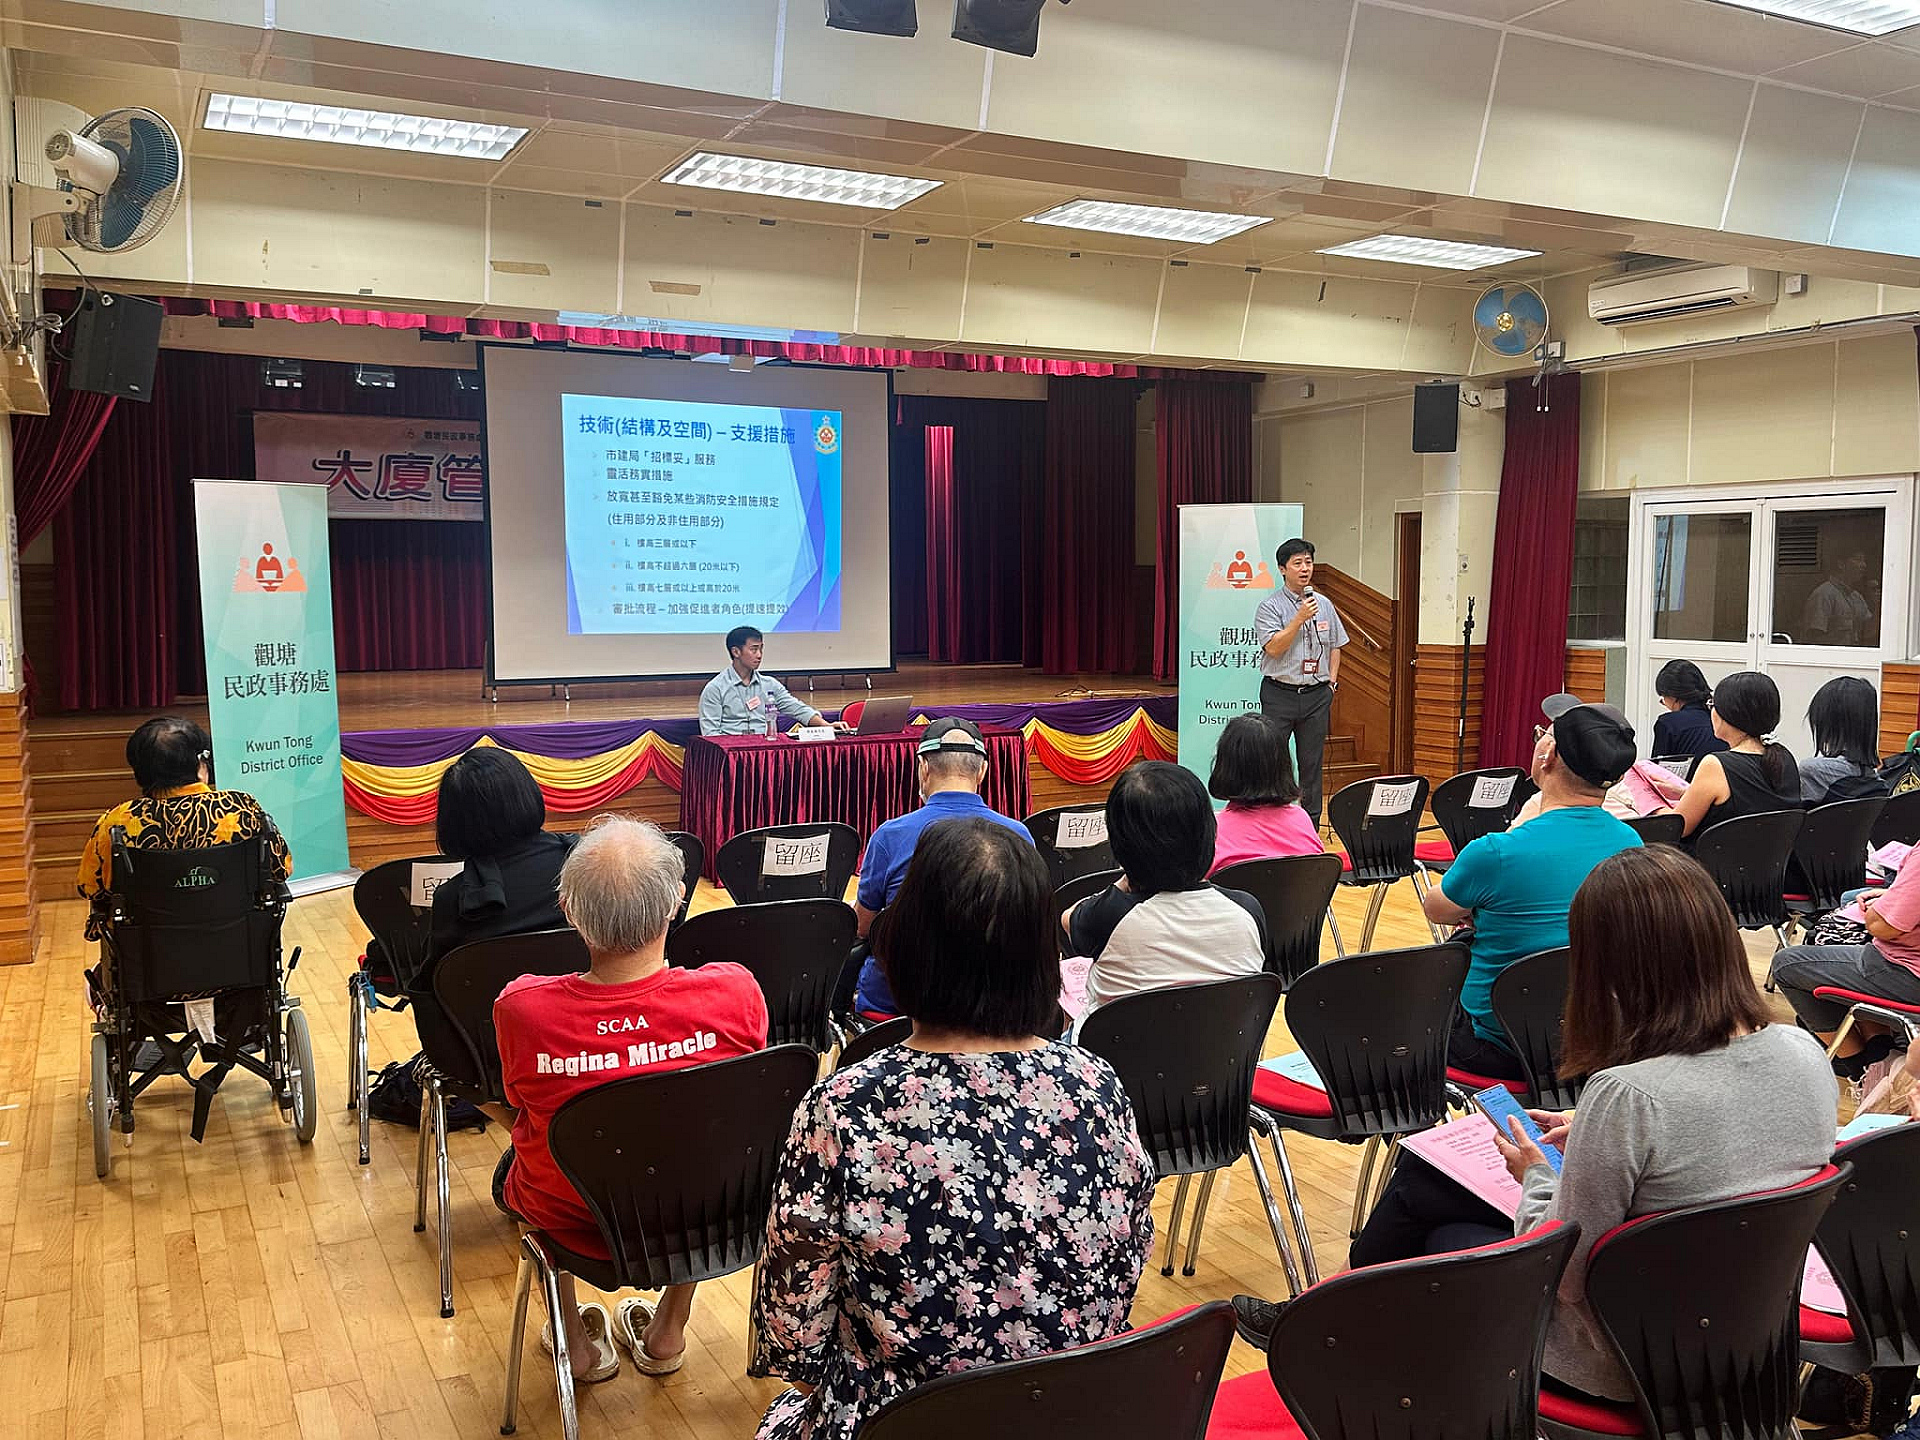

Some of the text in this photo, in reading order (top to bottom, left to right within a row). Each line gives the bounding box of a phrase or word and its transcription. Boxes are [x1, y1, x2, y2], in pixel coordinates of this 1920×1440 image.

[579, 414, 712, 442] 技術(結構及空間)
[730, 424, 796, 444] 支援措施
[312, 450, 482, 501] 大廈管
[607, 513, 724, 529] (住用部分及非住用部分)
[1219, 627, 1258, 646] 觀塘
[254, 642, 297, 667] 觀塘
[1190, 650, 1263, 668] 民政事
[224, 669, 330, 700] 民政事務處
[1205, 699, 1261, 709] Kwun Ton
[1199, 714, 1229, 725] Distri
[246, 735, 313, 753] Kwun Tong
[241, 753, 323, 774] District Office
[1380, 786, 1412, 807] 留座
[1068, 816, 1107, 838] 留座
[775, 842, 822, 865] 留座
[172, 875, 216, 887] ALPHA
[596, 1014, 649, 1035] SCAA
[536, 1030, 718, 1077] Regina Miracle
